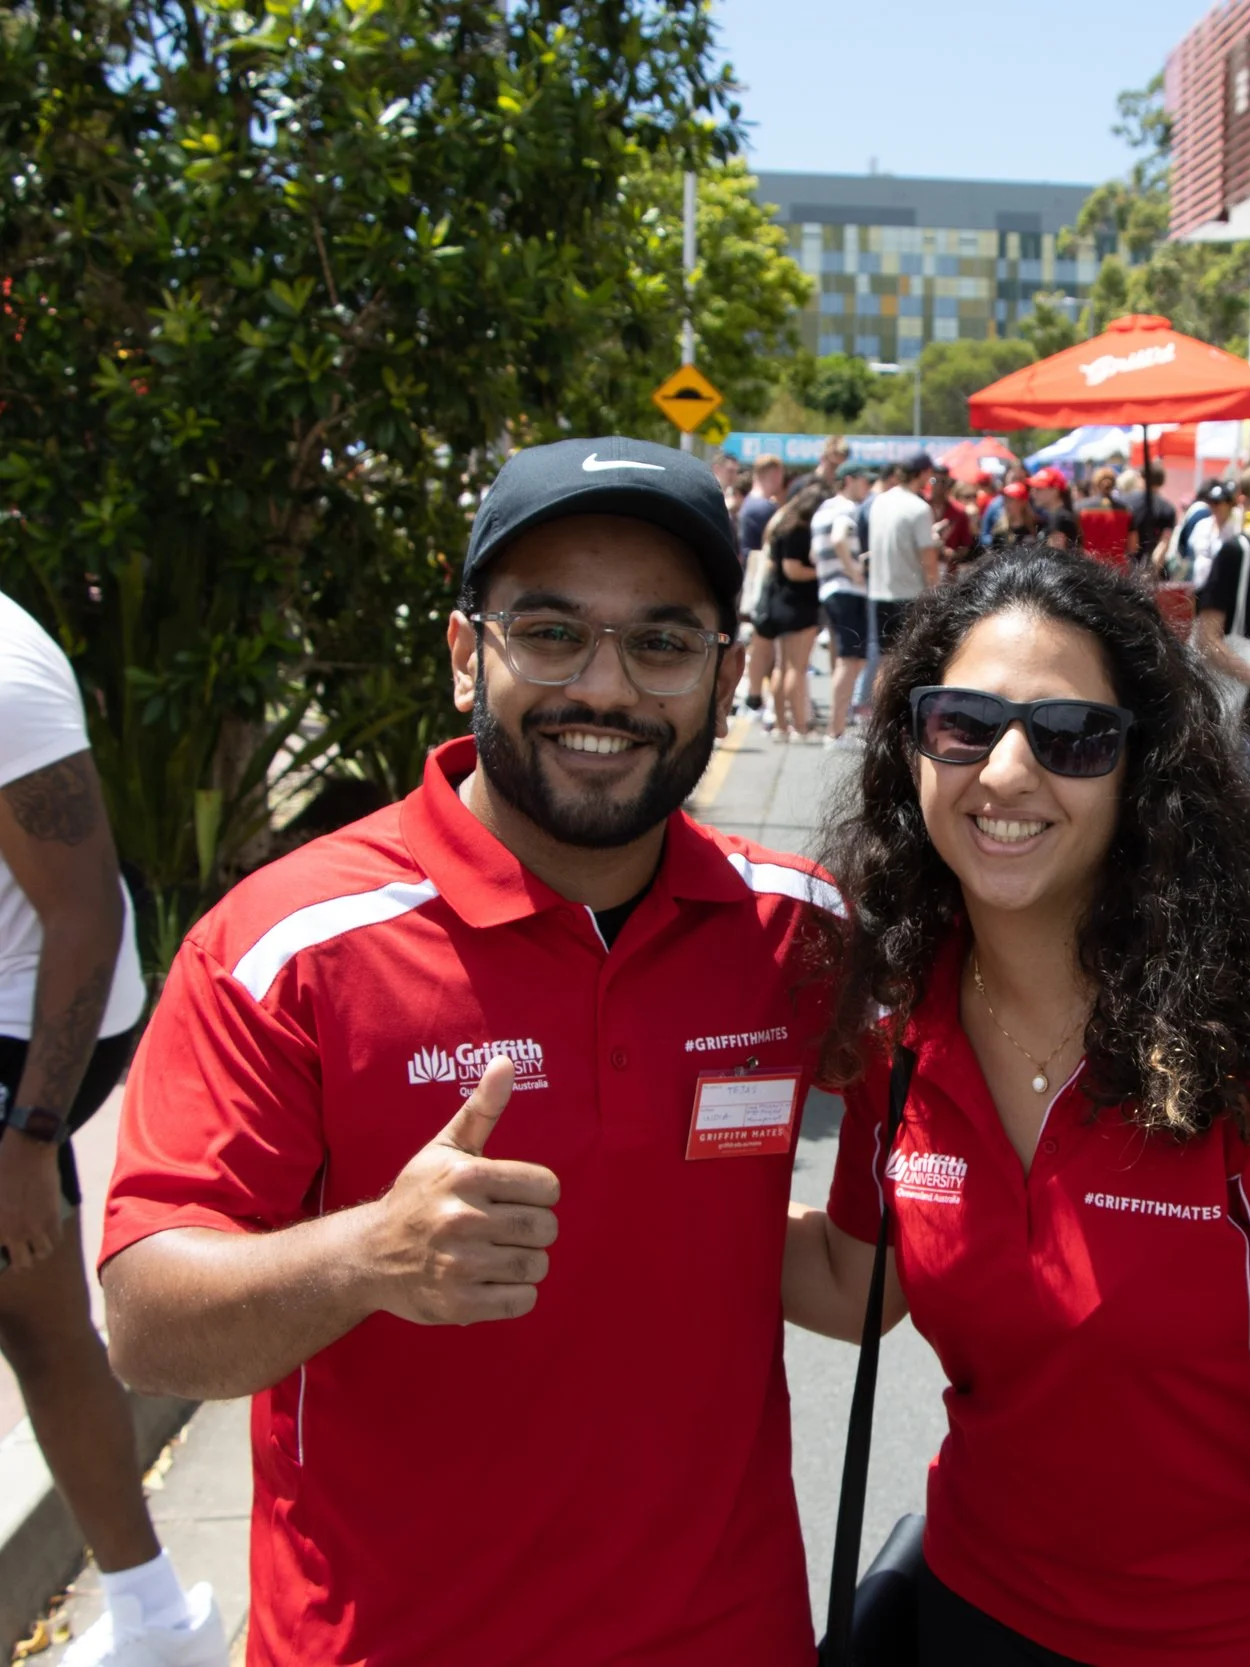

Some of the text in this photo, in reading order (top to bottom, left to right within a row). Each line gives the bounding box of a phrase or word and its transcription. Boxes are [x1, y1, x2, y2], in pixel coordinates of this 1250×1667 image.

[684, 1027, 788, 1052] #GRIFFITHMATES
[455, 1038, 543, 1066] Griffith
[458, 1059, 543, 1080] UNISITY
[512, 1079, 549, 1092] Australia
[699, 1128, 785, 1142] GRIFFITH MATES
[909, 1151, 968, 1177] Griffith
[903, 1171, 965, 1189] UNIVERSITY
[1083, 1192, 1222, 1221] #GRIFFITHMATES
